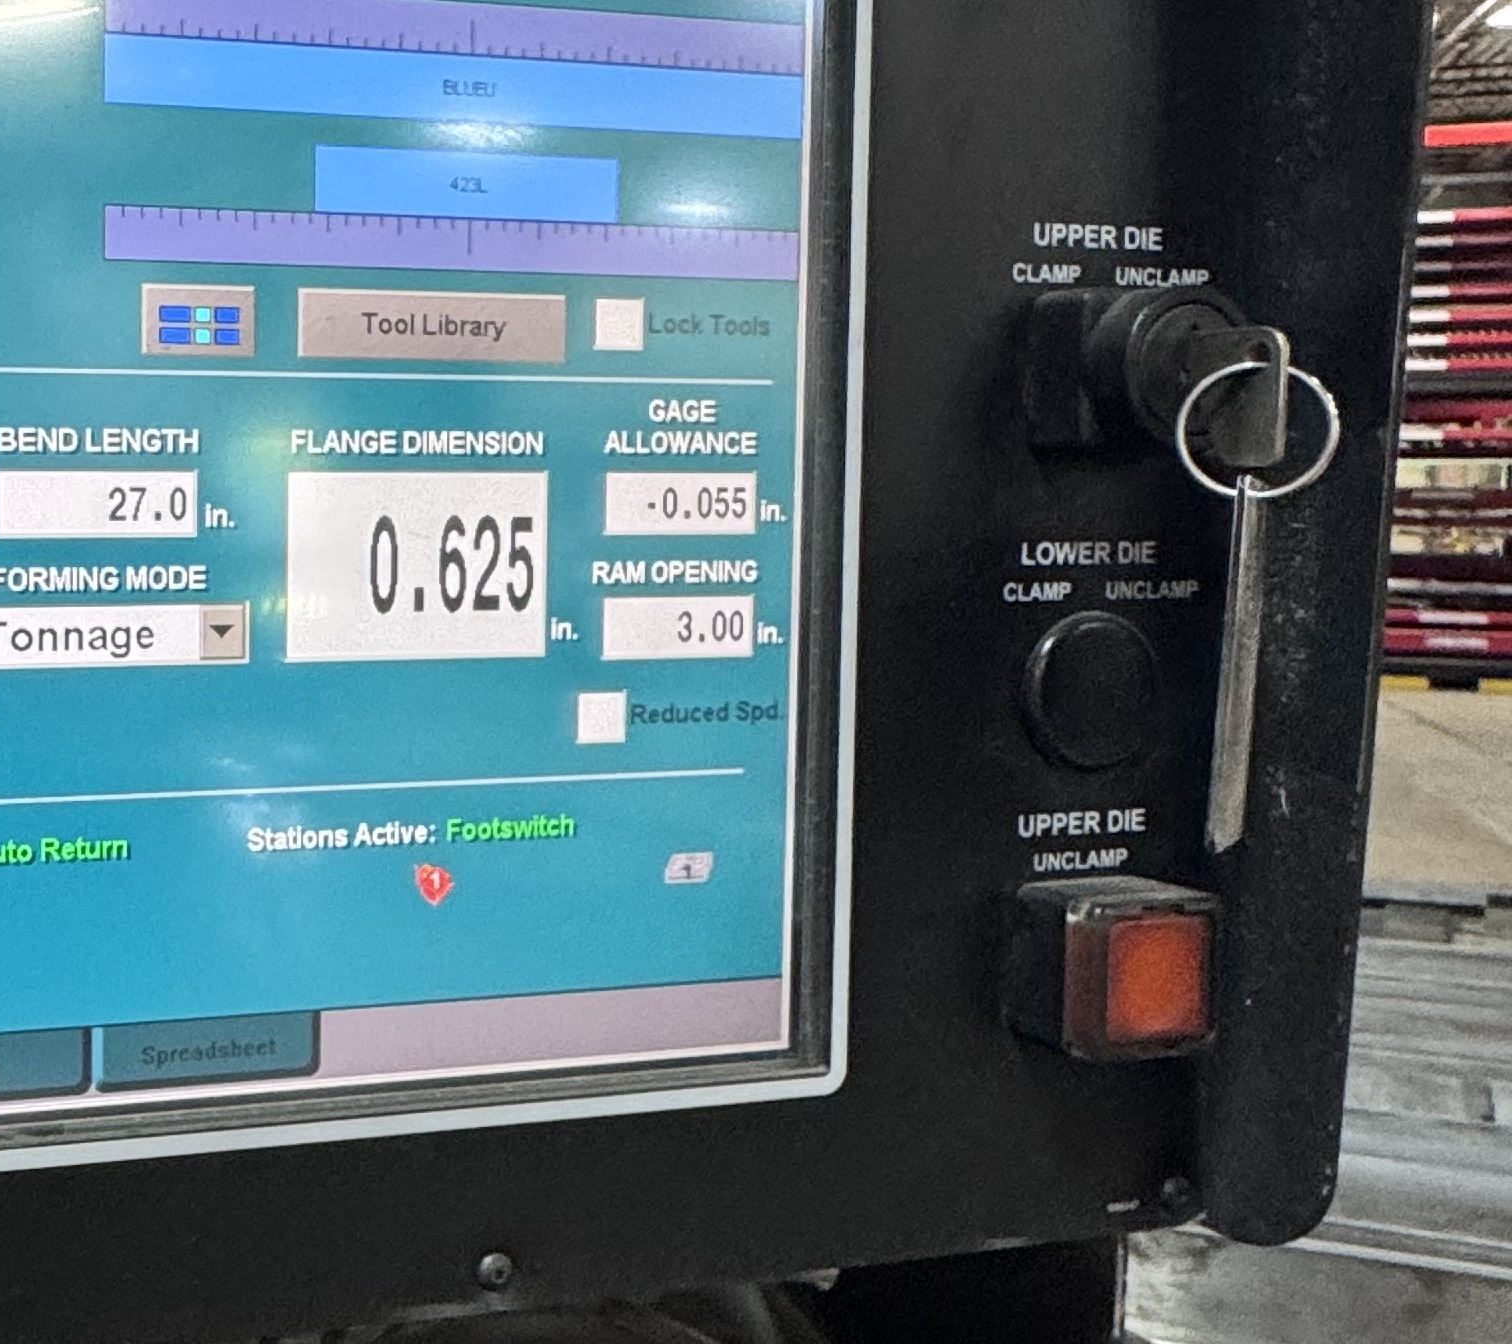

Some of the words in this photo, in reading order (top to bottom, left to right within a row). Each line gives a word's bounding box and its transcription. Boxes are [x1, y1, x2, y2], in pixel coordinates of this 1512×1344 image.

[1033, 223, 1117, 250] UPPER
[1117, 226, 1163, 251] DIE
[1013, 263, 1081, 284] CLAMP
[1115, 266, 1209, 288] UNCLAMP
[361, 312, 416, 336] Tool
[423, 313, 506, 342] Library
[647, 313, 702, 336] Lock
[708, 315, 771, 339] Tools
[648, 399, 717, 423] GAGE
[85, 428, 200, 455] LENGTH
[290, 430, 397, 455] FLANGE
[402, 430, 544, 456] DIMENSION
[604, 430, 757, 455] ALLOWANCE
[108, 486, 188, 523] 27.0
[204, 503, 236, 529] in.
[646, 486, 748, 520] -0.055
[760, 499, 788, 522] in.
[1021, 541, 1111, 566] LOWER
[1118, 540, 1158, 564] DIE
[126, 565, 208, 591] MODE
[369, 514, 535, 614] 0.625
[550, 617, 580, 641] in.
[592, 560, 646, 584] RAM
[651, 560, 758, 584] OPENING
[1003, 582, 1072, 602] CLAMP
[1105, 579, 1199, 599] UNCLAMP
[677, 609, 745, 643] 3.00
[757, 621, 785, 644] in.
[631, 702, 729, 725] Reduced
[247, 825, 348, 852] Stations
[353, 821, 437, 847] Active:
[445, 813, 576, 843] Footswitch
[1018, 811, 1102, 839] UPPER
[1107, 809, 1146, 834] DIE
[41, 836, 128, 864] Return
[1033, 847, 1128, 873] UNCLAMP
[141, 1036, 277, 1066] Spreadsheet
